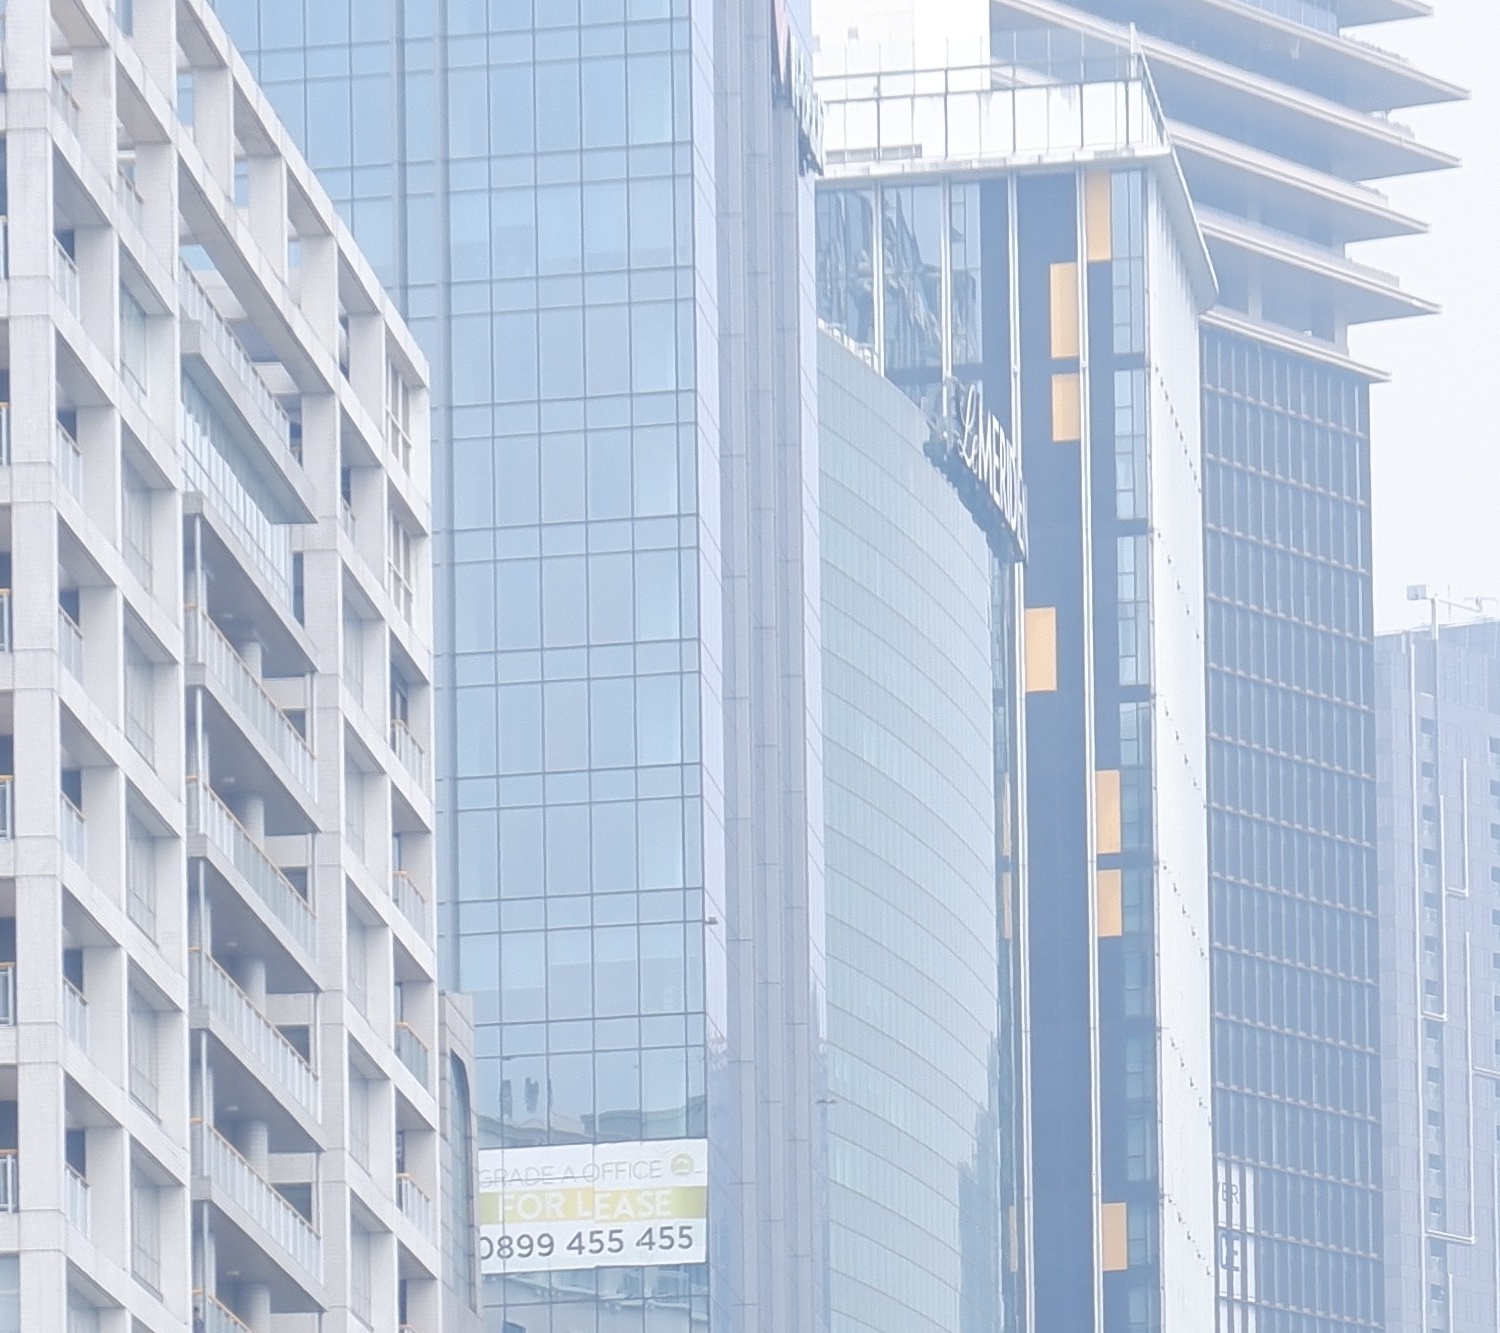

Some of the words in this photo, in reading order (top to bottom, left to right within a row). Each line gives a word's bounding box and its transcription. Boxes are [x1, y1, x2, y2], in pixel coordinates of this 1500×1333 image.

[479, 1166, 554, 1189] GRADE
[562, 1166, 578, 1184] A
[582, 1160, 661, 1183] OFFICE
[498, 1190, 564, 1221] FOR
[576, 1190, 672, 1220] LEASE
[479, 1233, 555, 1260] 0899
[566, 1229, 624, 1256] 455
[635, 1225, 693, 1250] 455
